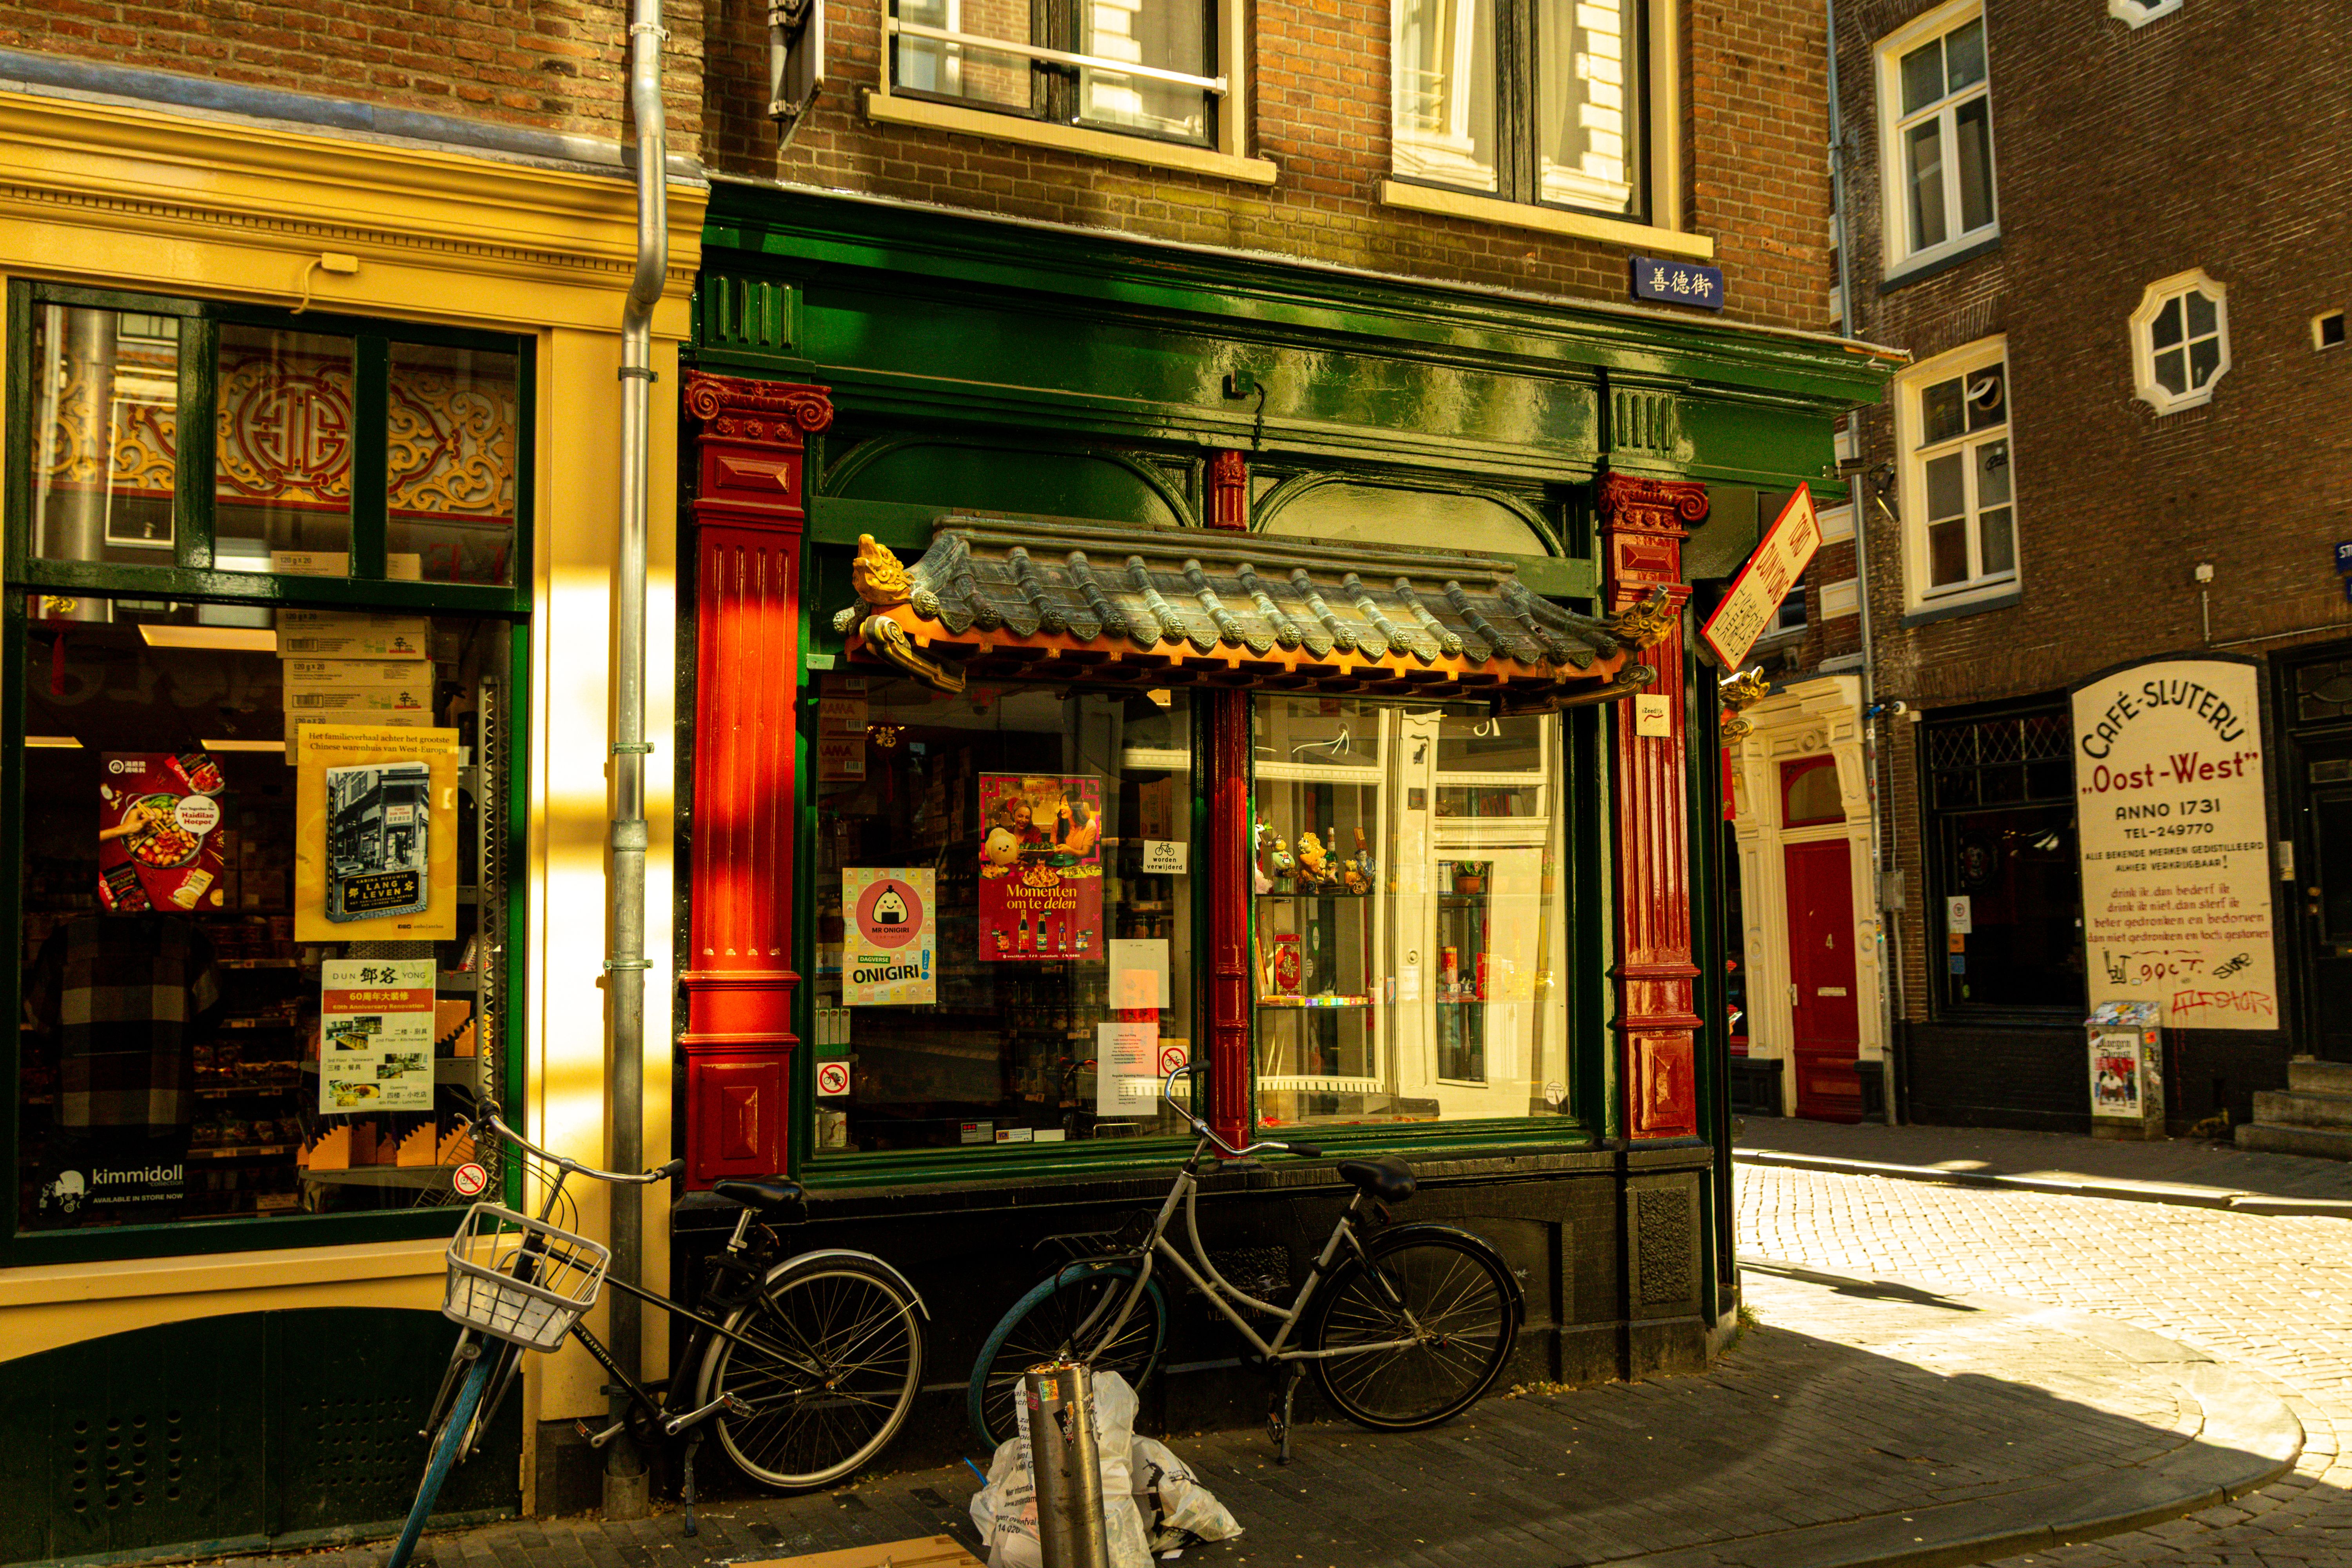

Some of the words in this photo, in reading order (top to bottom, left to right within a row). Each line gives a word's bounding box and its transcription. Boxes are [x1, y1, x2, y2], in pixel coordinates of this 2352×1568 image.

[1649, 267, 1713, 298] 善德街
[1788, 512, 1811, 557] TOKO
[1755, 541, 1781, 584] DUN
[1764, 561, 1790, 606] YONG
[325, 733, 379, 741] familieverhaal
[419, 736, 450, 744] grootste
[399, 746, 447, 755] West-Europa
[2116, 803, 2170, 820] ANNO
[2180, 798, 2220, 816] 1731
[2124, 823, 2214, 838] TEL-249770
[2106, 848, 2145, 860] BEKENDE
[2149, 846, 2188, 856] MERKEN
[366, 880, 398, 891] LANG
[1007, 884, 1077, 897] Momenten
[363, 888, 401, 899] LEVEN
[1007, 900, 1026, 909] om
[1029, 898, 1042, 909] te
[1044, 897, 1076, 909] delen
[1825, 933, 1834, 949] 4
[93, 1164, 183, 1185] kimmidoll
[93, 1195, 131, 1204] AVAILABLE
[581, 1331, 612, 1365] SWAPFIETS
[998, 1524, 1005, 1532] 14
